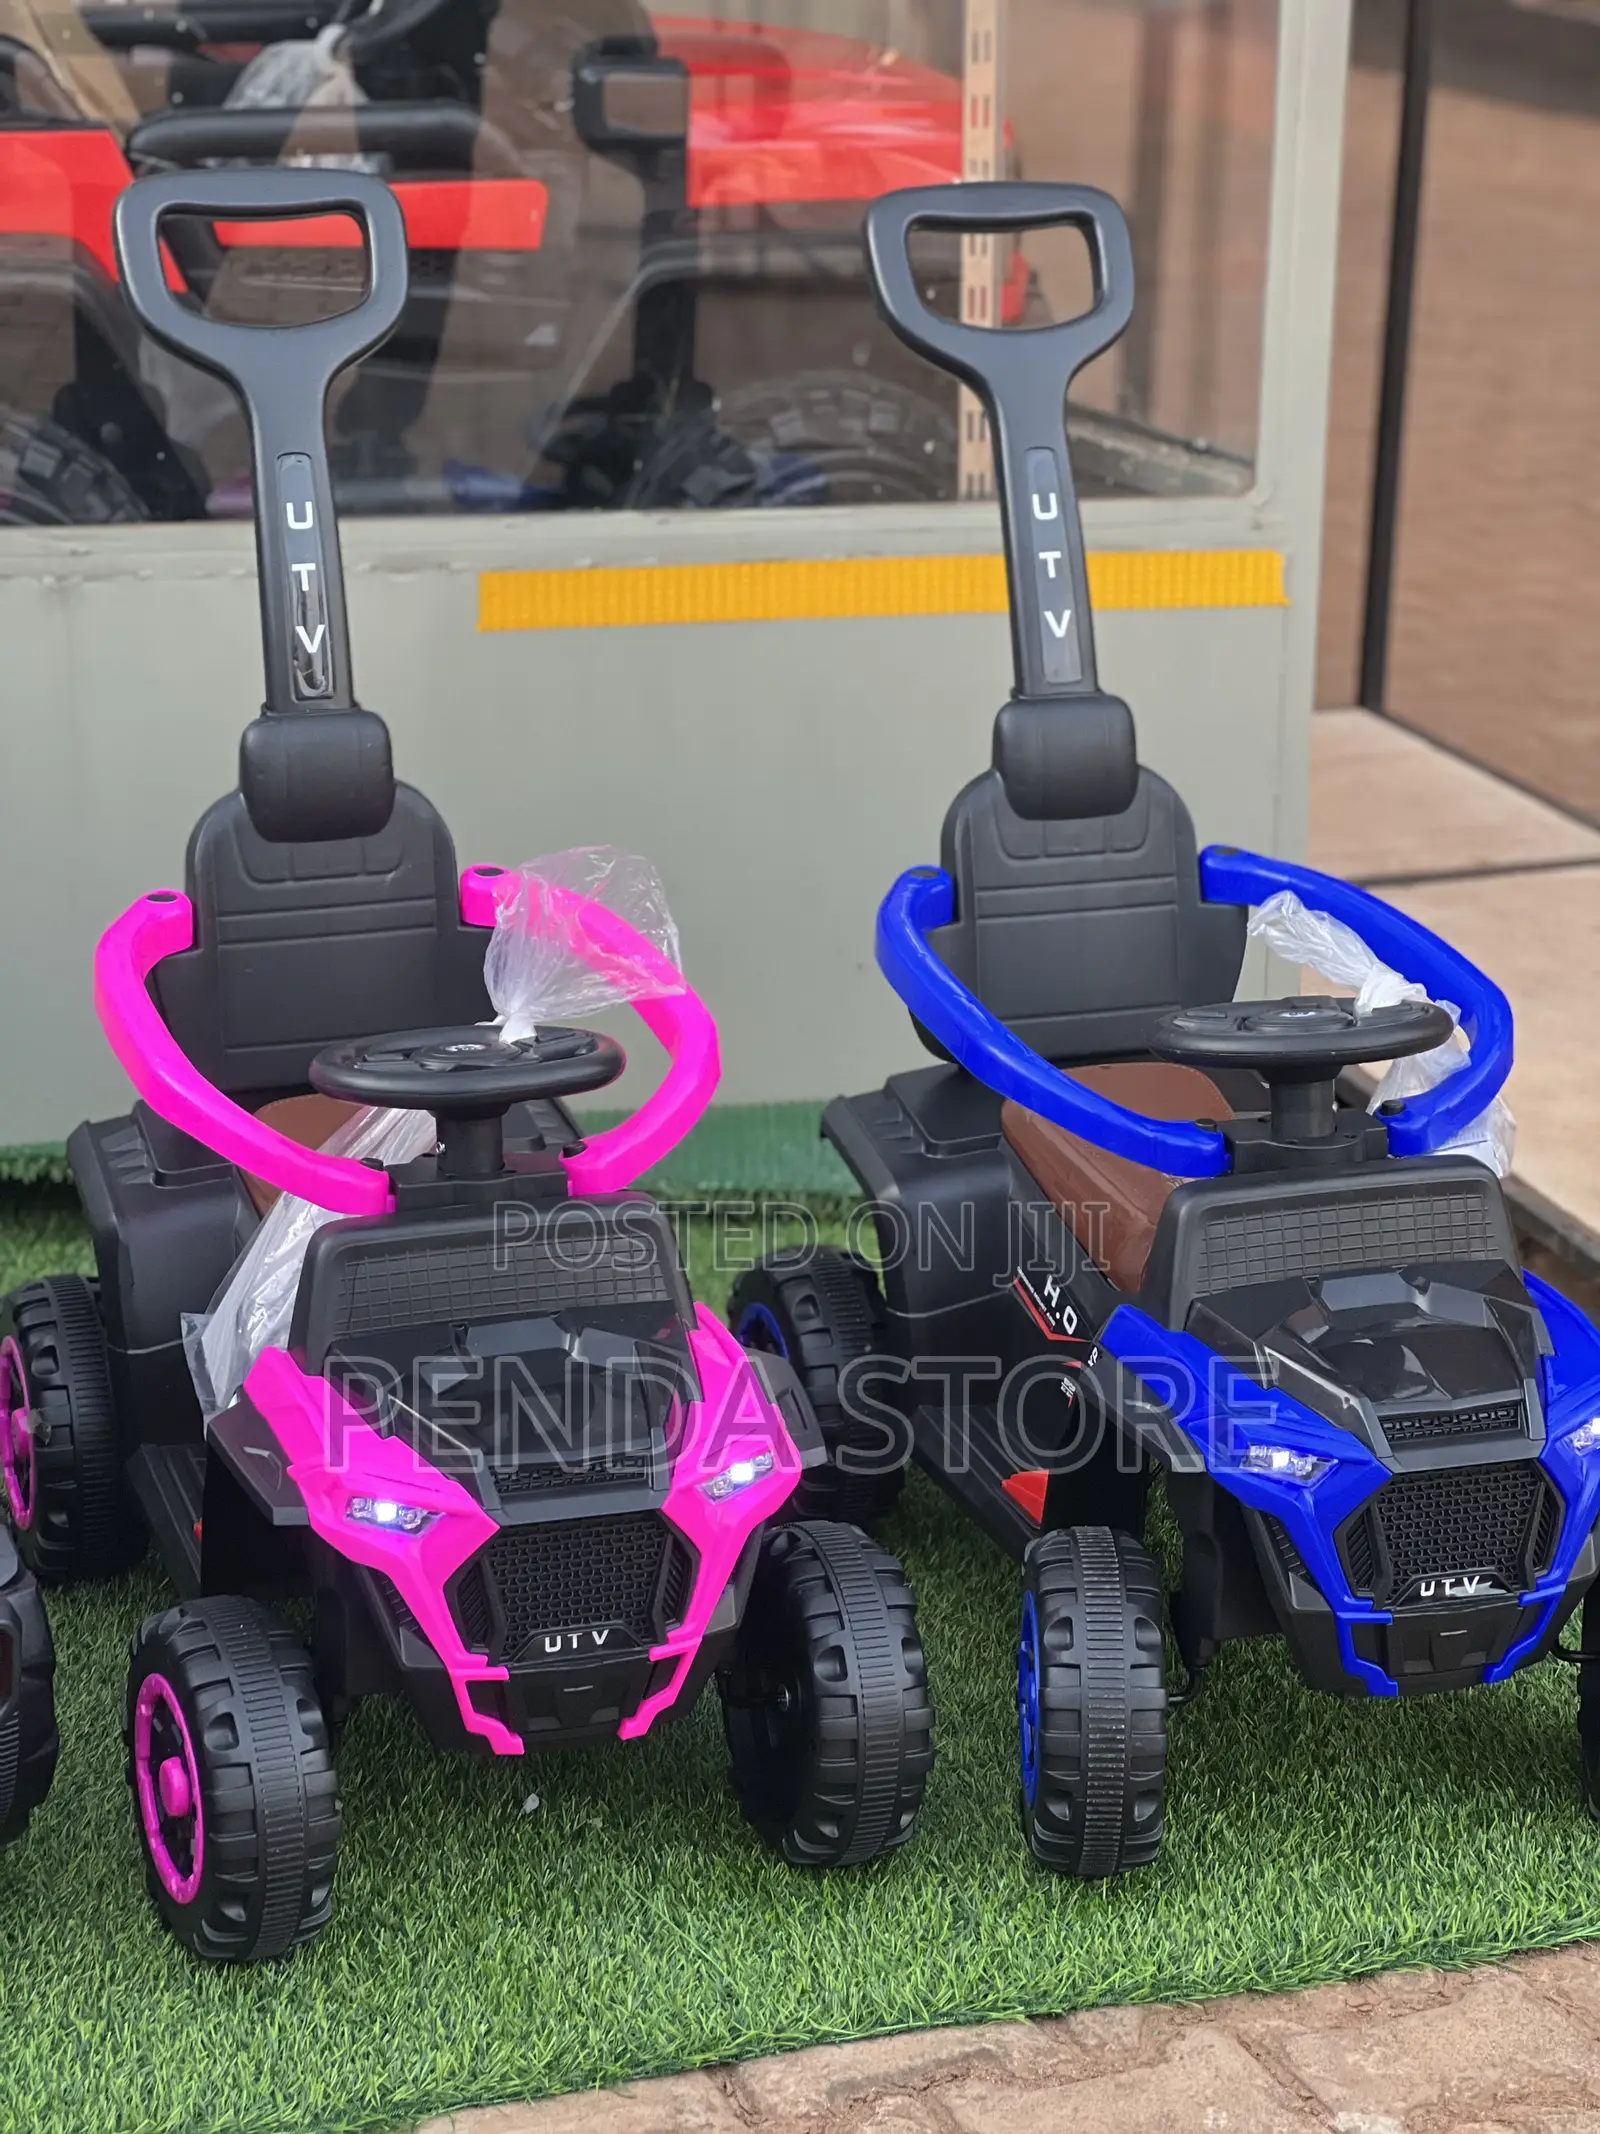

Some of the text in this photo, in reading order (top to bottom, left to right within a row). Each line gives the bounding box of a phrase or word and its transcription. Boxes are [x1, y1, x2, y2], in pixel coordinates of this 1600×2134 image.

[286, 501, 325, 653] UTV
[1032, 492, 1071, 638] UTV
[1420, 1576, 1480, 1597] UTV
[544, 1629, 609, 1653] UTV
